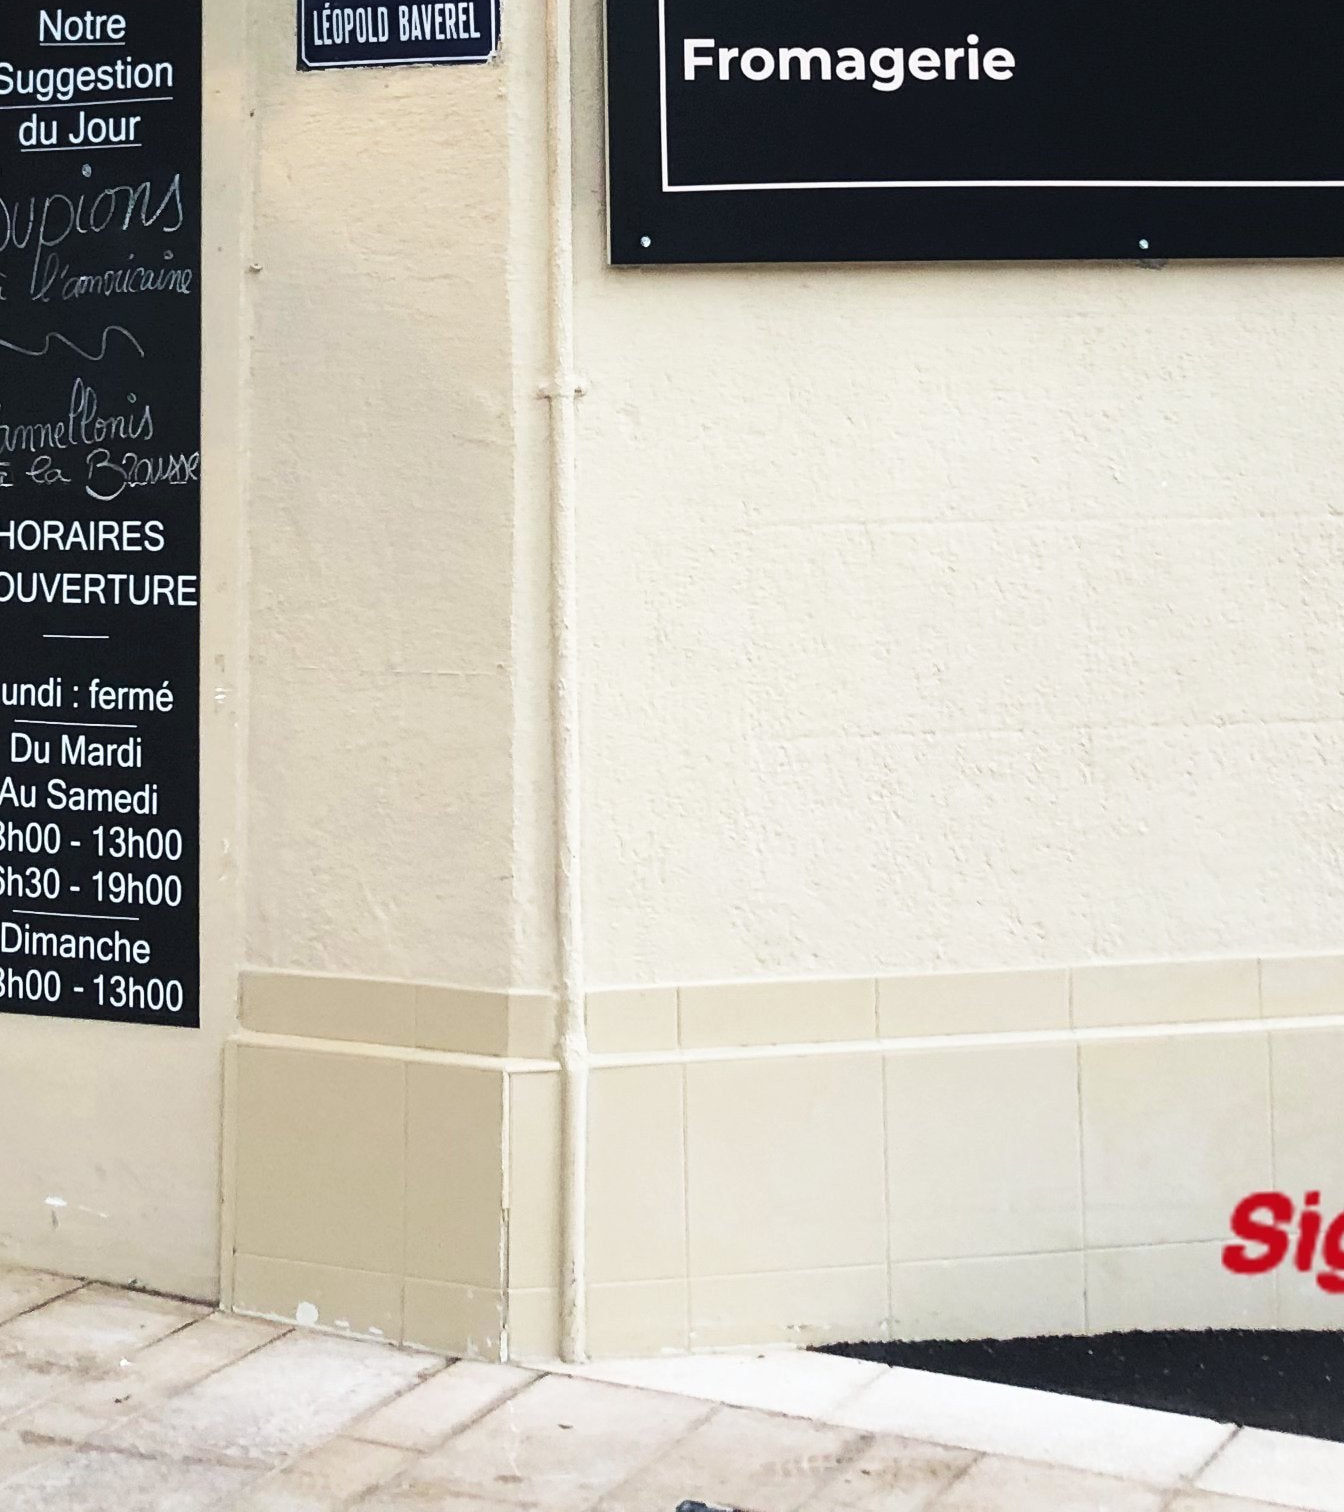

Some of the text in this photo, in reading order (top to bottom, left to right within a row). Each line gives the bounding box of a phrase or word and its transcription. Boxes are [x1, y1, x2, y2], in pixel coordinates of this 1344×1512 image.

[39, 8, 126, 41] Notre
[313, 2, 480, 45] LÉOPOLD BAVEREL
[684, 34, 1015, 91] Fromagerie
[19, 111, 141, 146] du Jour
[26, 455, 72, 485] la
[89, 679, 173, 711] fermé
[11, 733, 141, 767] Du Mardi
[47, 779, 157, 814] Samedi
[93, 826, 182, 860] 13h00
[93, 871, 181, 906] 19h00
[0, 921, 151, 965] Dimanche
[94, 974, 183, 1011] 13h00
